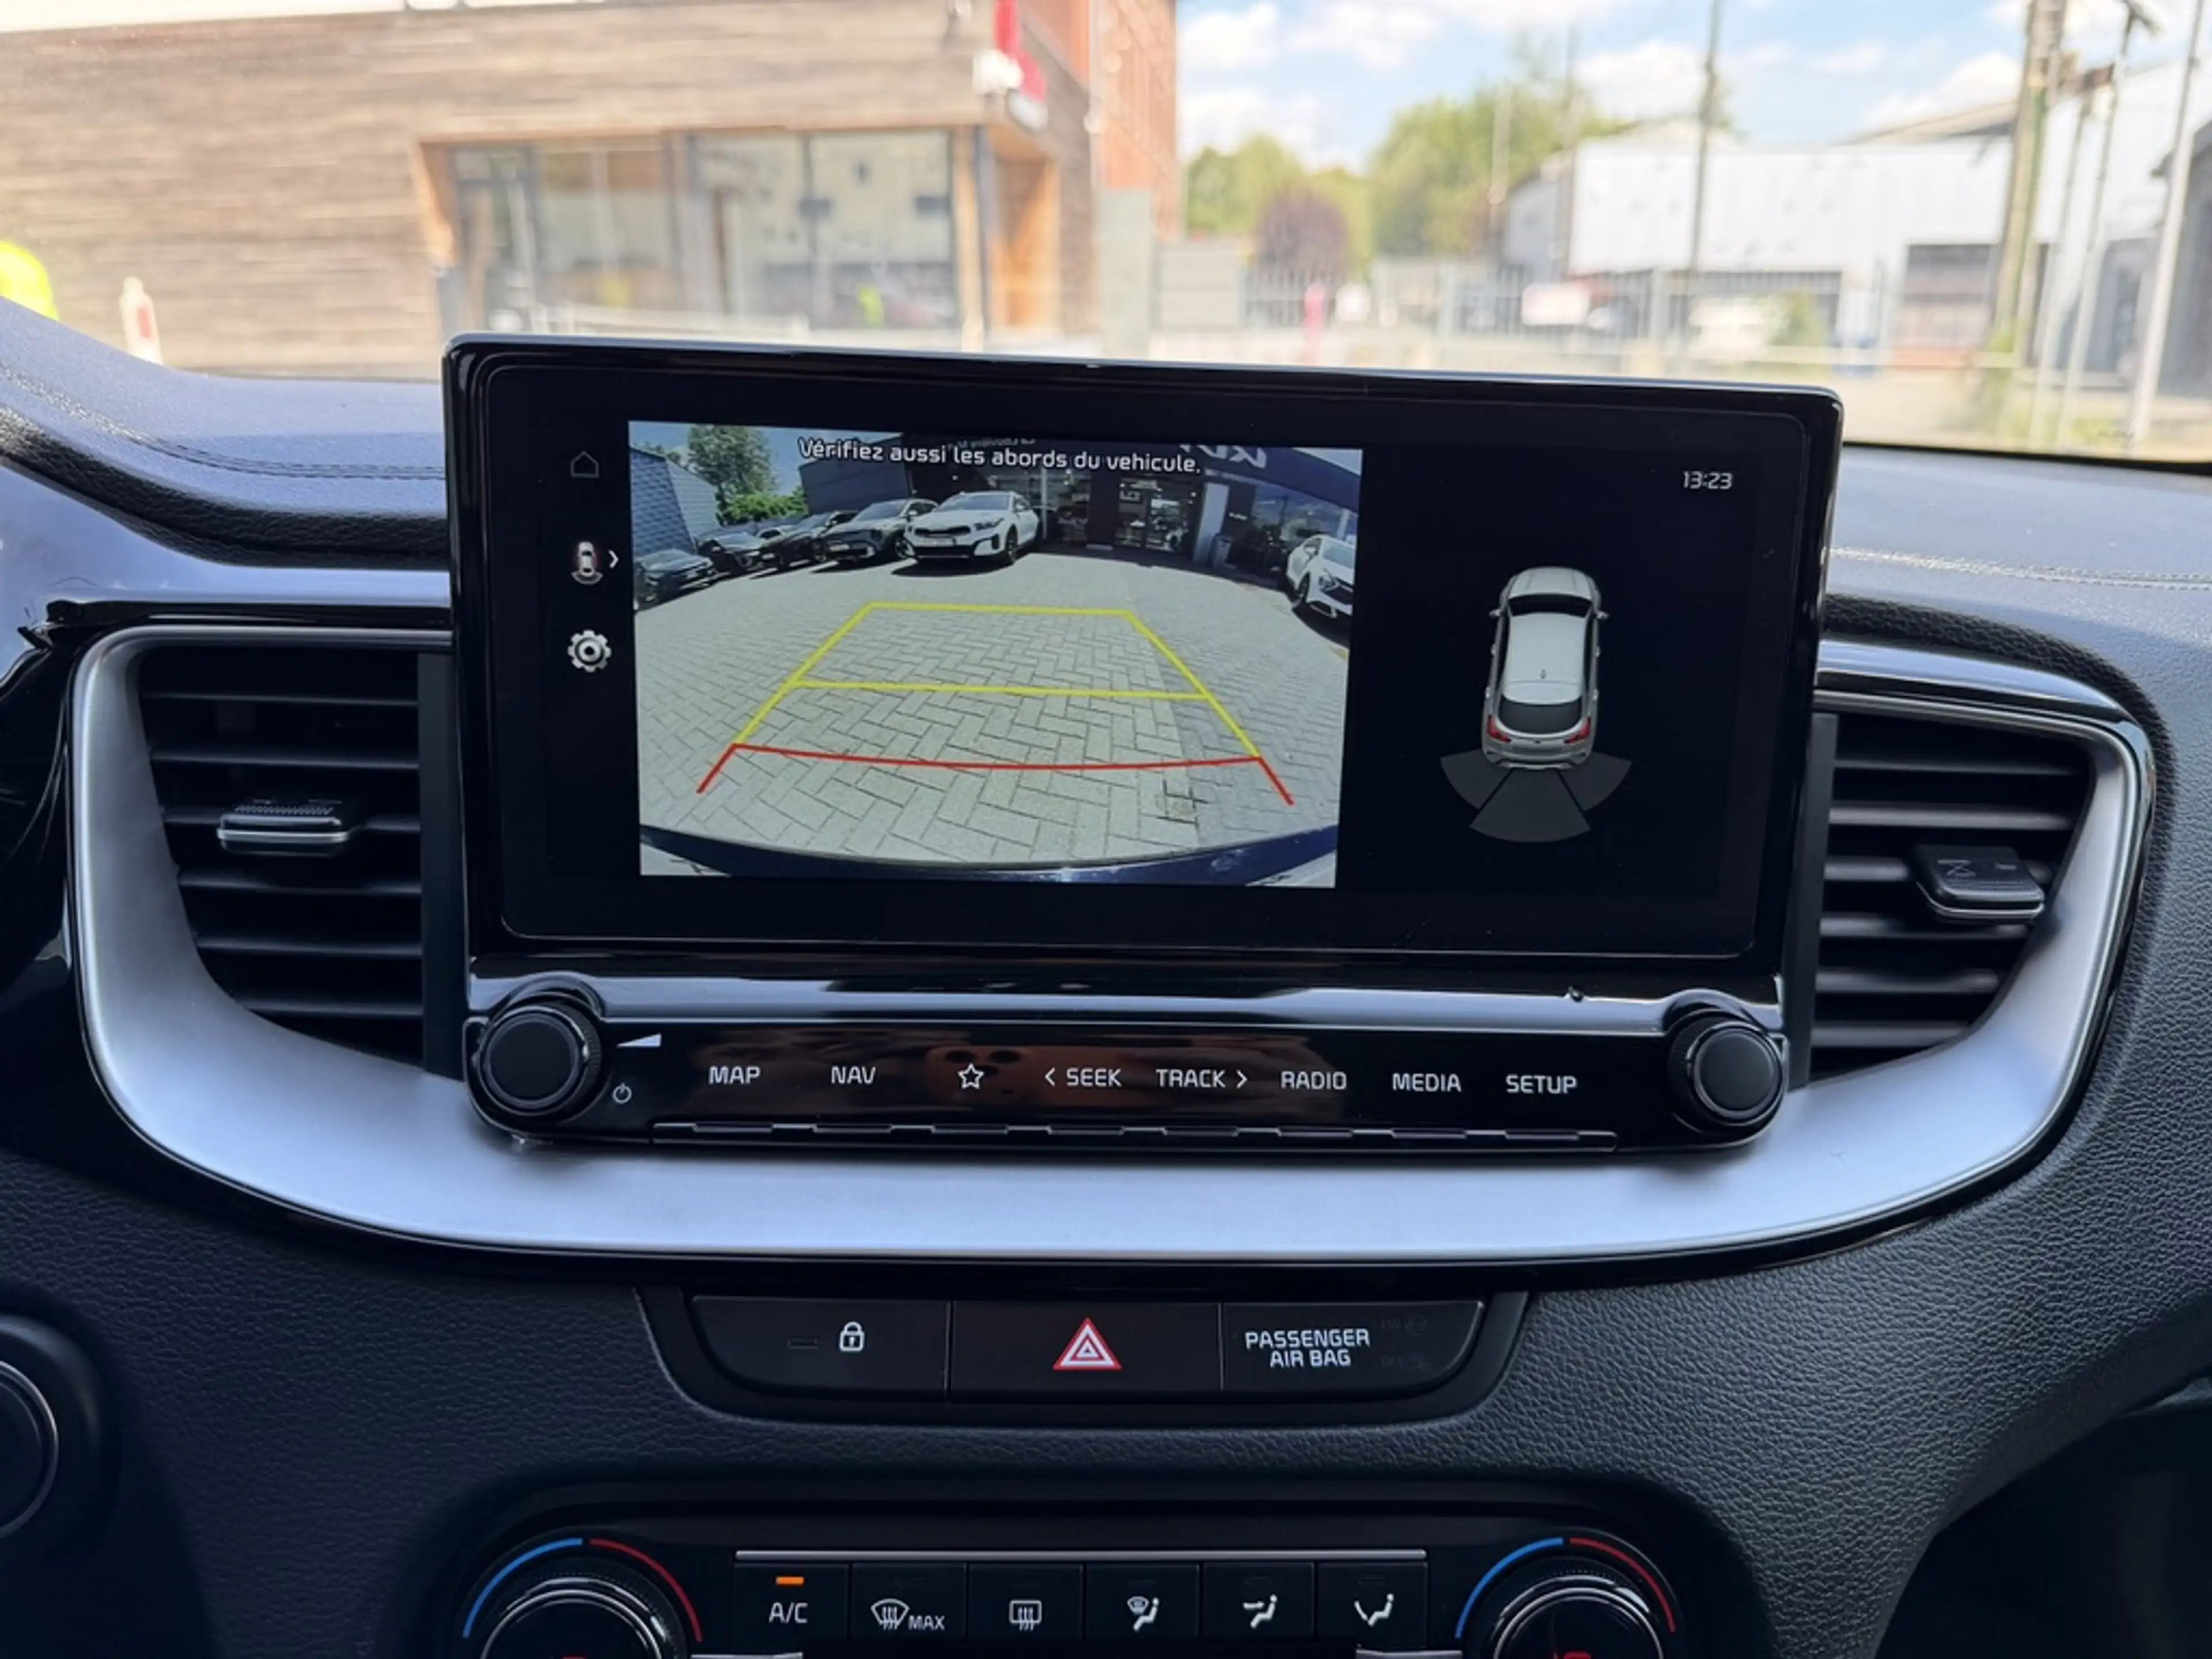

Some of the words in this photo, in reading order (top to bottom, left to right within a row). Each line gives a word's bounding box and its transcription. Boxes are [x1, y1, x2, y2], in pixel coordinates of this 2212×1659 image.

[800, 439, 883, 460] Vérifiez
[891, 446, 945, 461] aussi
[955, 447, 984, 463] les
[991, 448, 1067, 468] abords
[1075, 452, 1099, 468] du
[1684, 471, 1732, 489] 13:23
[710, 1066, 760, 1084] MAP
[832, 1067, 875, 1083] NAV
[1067, 1069, 1120, 1086] SEEK
[1156, 1070, 1225, 1087] TRACK
[1282, 1071, 1346, 1089] RADIO
[1393, 1074, 1461, 1091] MEDIA
[1507, 1075, 1575, 1093] SETUP
[1245, 1328, 1370, 1349] PASSENGER
[1270, 1351, 1303, 1368] AIR
[1309, 1349, 1351, 1367] BAG
[769, 1603, 807, 1623] A/C
[909, 1615, 944, 1630] MAX
